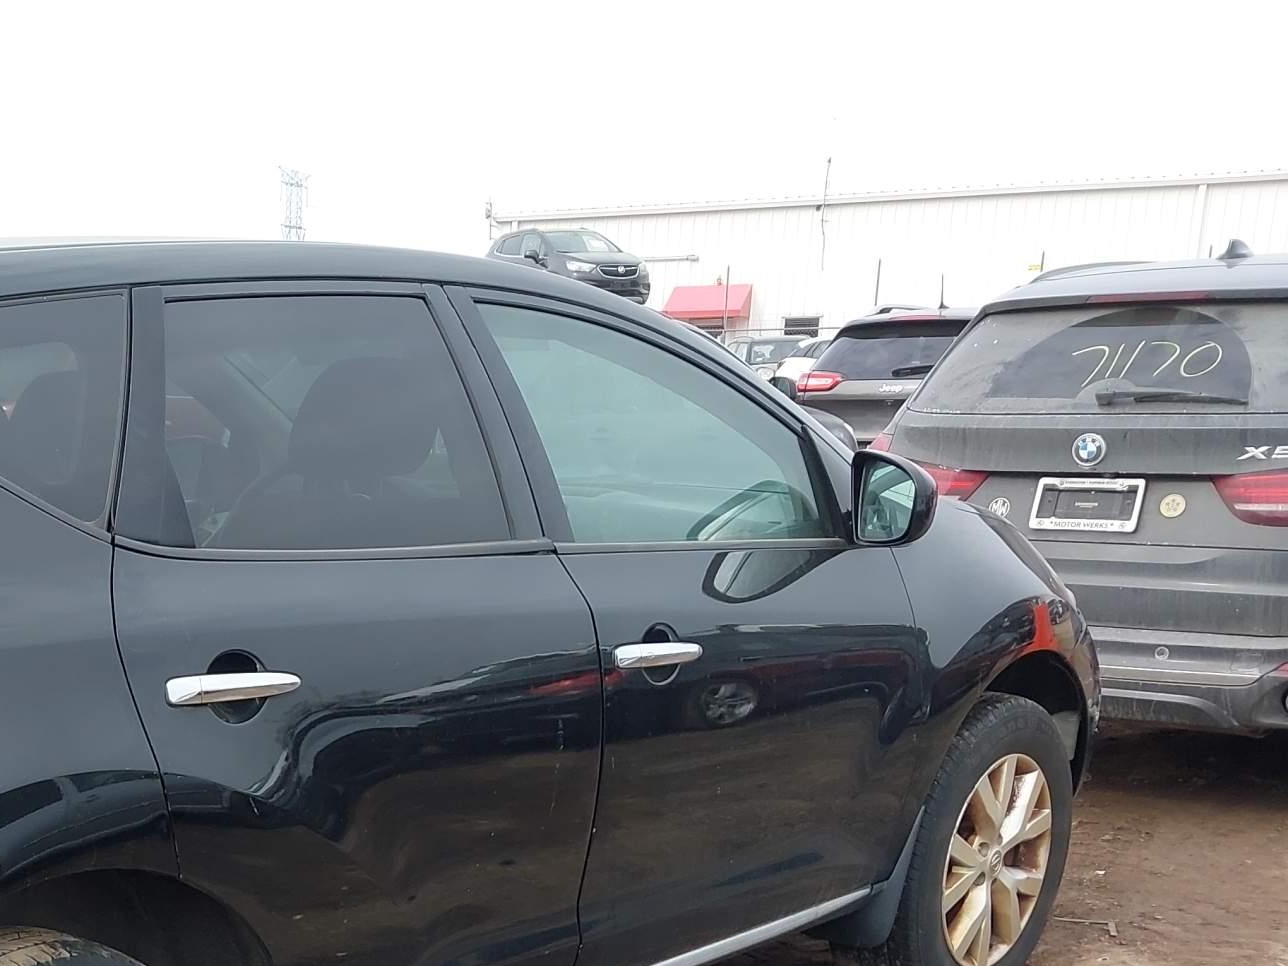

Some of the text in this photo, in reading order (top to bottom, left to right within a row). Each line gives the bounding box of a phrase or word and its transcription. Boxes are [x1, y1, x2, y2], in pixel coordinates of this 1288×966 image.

[879, 384, 903, 393] Jeep
[1053, 520, 1109, 529] MOTOR WERKS
